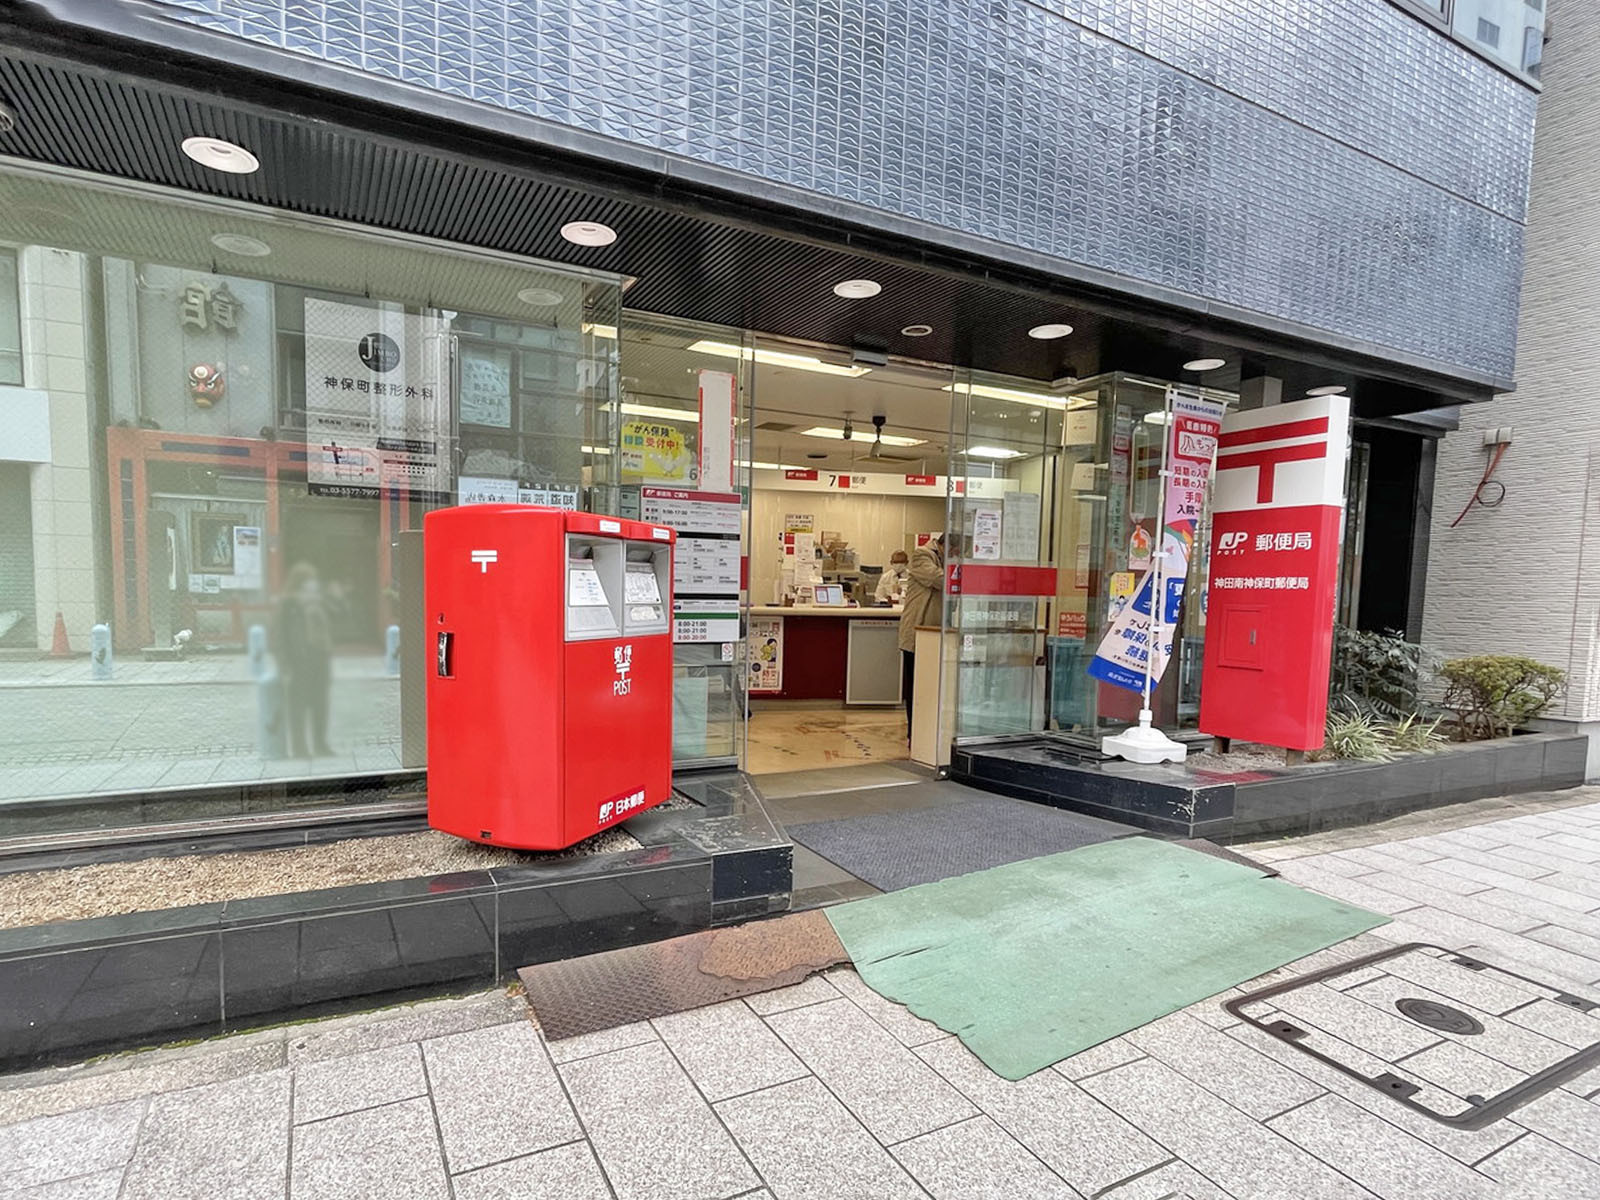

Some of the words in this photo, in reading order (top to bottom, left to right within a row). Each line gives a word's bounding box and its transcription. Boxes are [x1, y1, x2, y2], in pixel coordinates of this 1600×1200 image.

[323, 376, 434, 400] 神保町整形外科
[689, 468, 698, 481] 6
[829, 475, 837, 487] 7
[1255, 532, 1312, 551] 郵便局
[1214, 576, 1309, 590] 神田南神保町郵便局
[613, 645, 632, 665] 郵便
[613, 679, 632, 697] POST
[615, 790, 645, 816] 日本郵便
